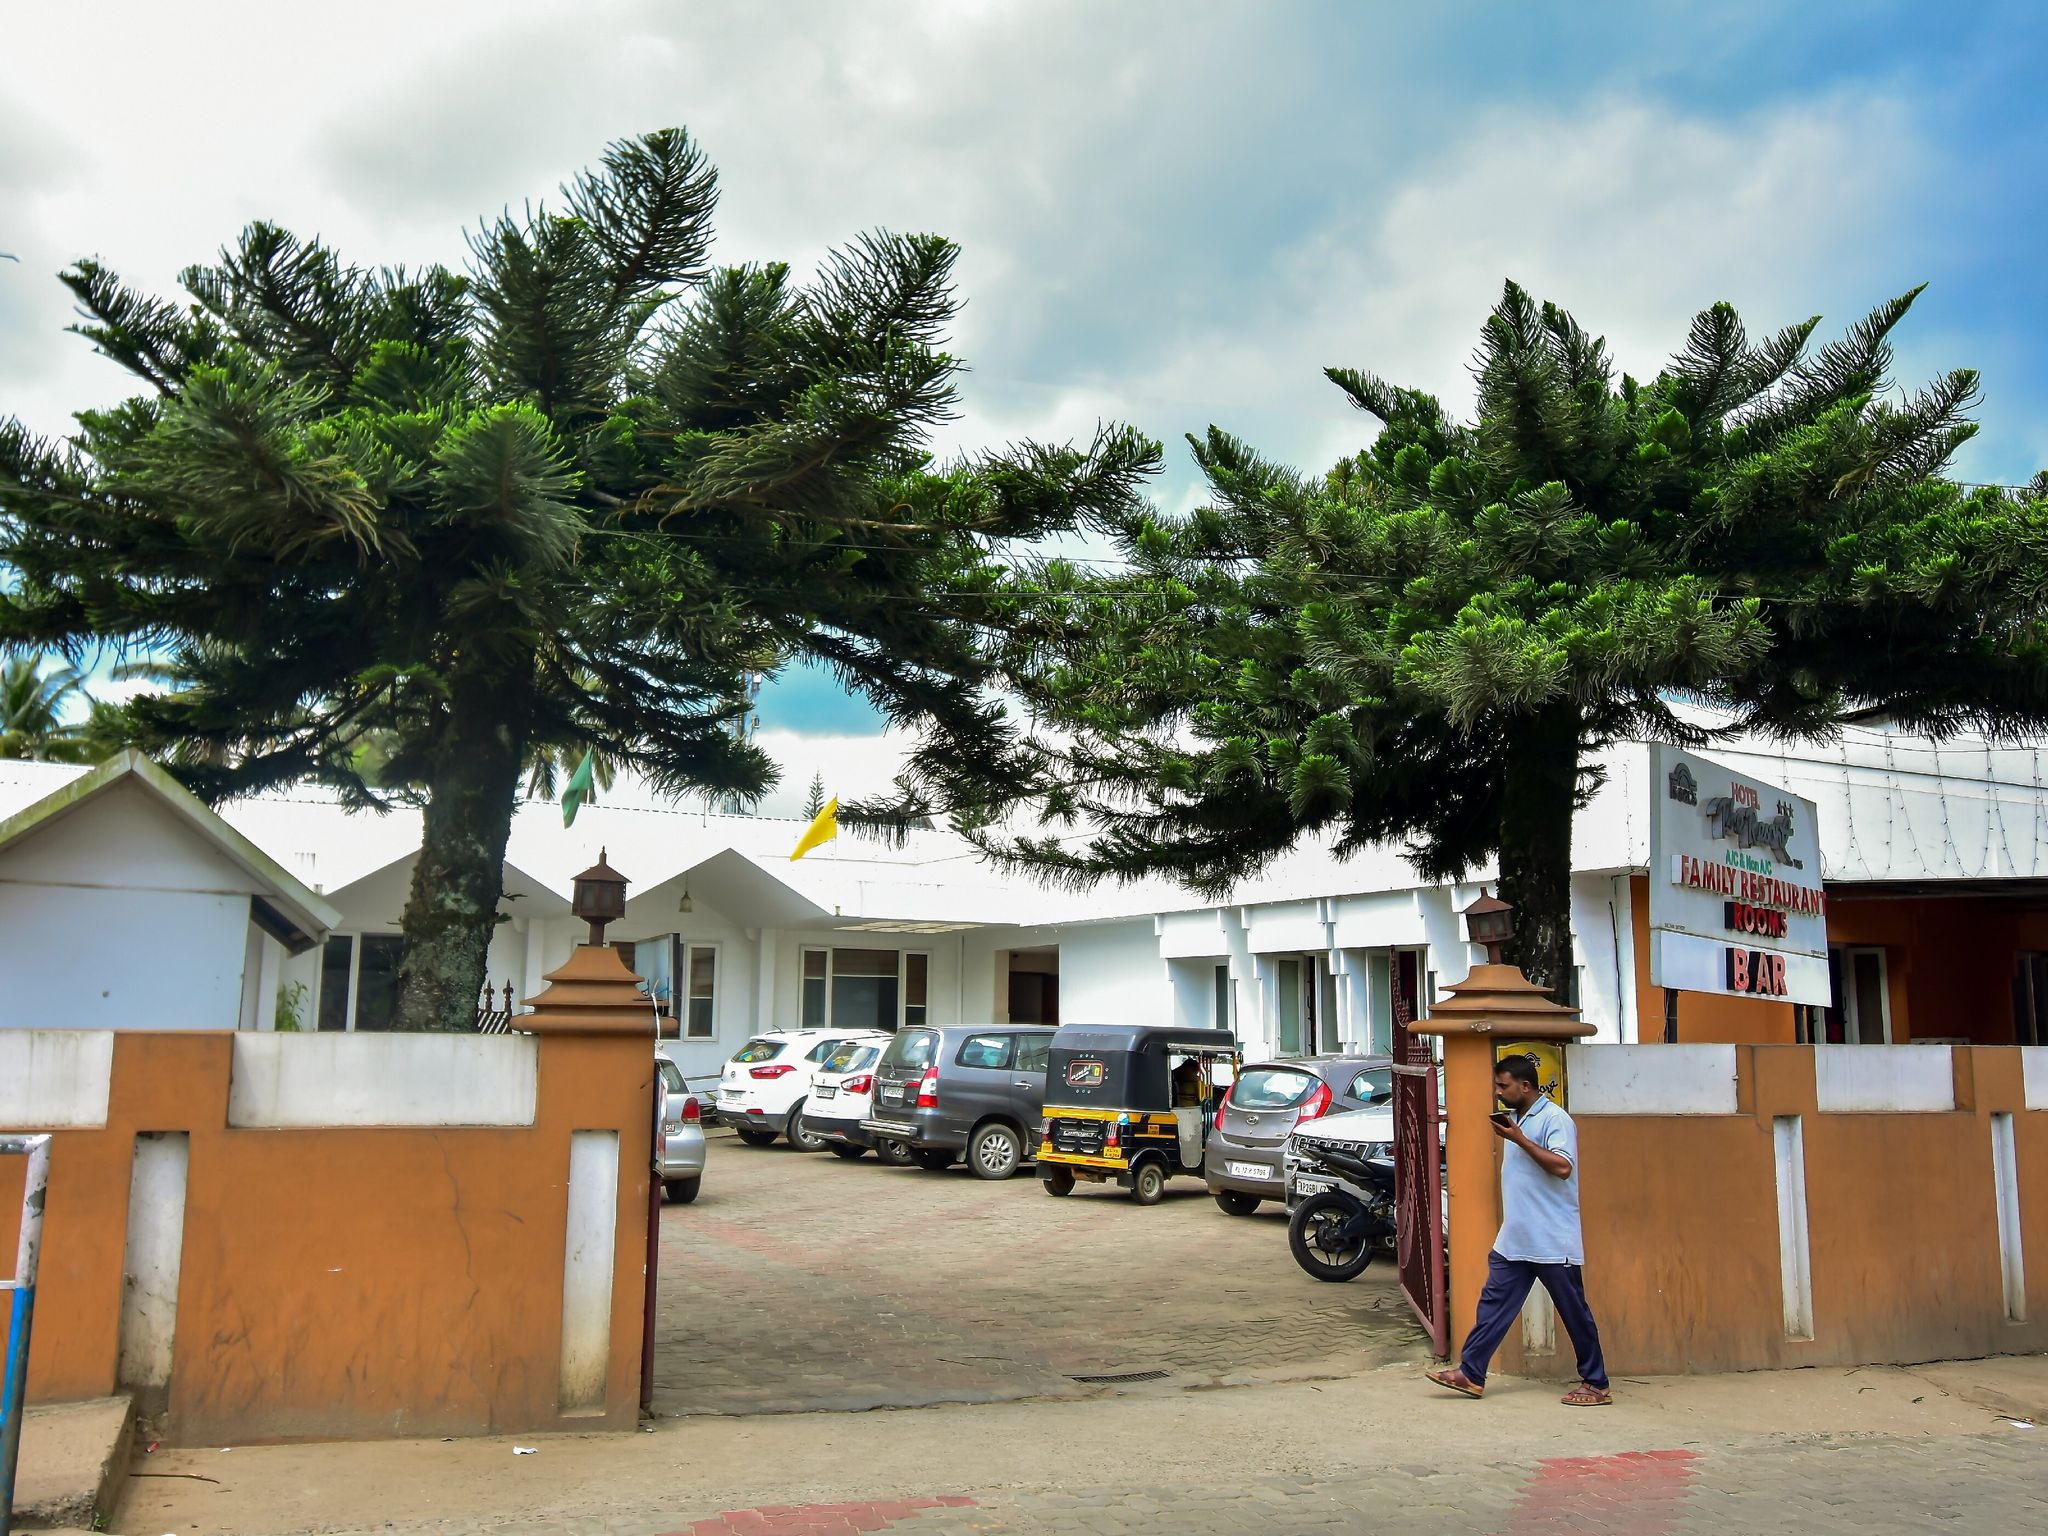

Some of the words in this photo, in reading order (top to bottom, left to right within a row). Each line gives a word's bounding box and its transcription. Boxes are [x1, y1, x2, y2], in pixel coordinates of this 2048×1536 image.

[1731, 782, 1760, 810] HOTEL
[1726, 849, 1738, 867] A/C
[1739, 852, 1745, 869] &
[1746, 854, 1759, 873] Non
[1681, 855, 1736, 895] FAMILY
[1740, 870, 1827, 916] RESTAURANT
[1732, 902, 1788, 938] ROOMS
[1733, 948, 1788, 996] BAR
